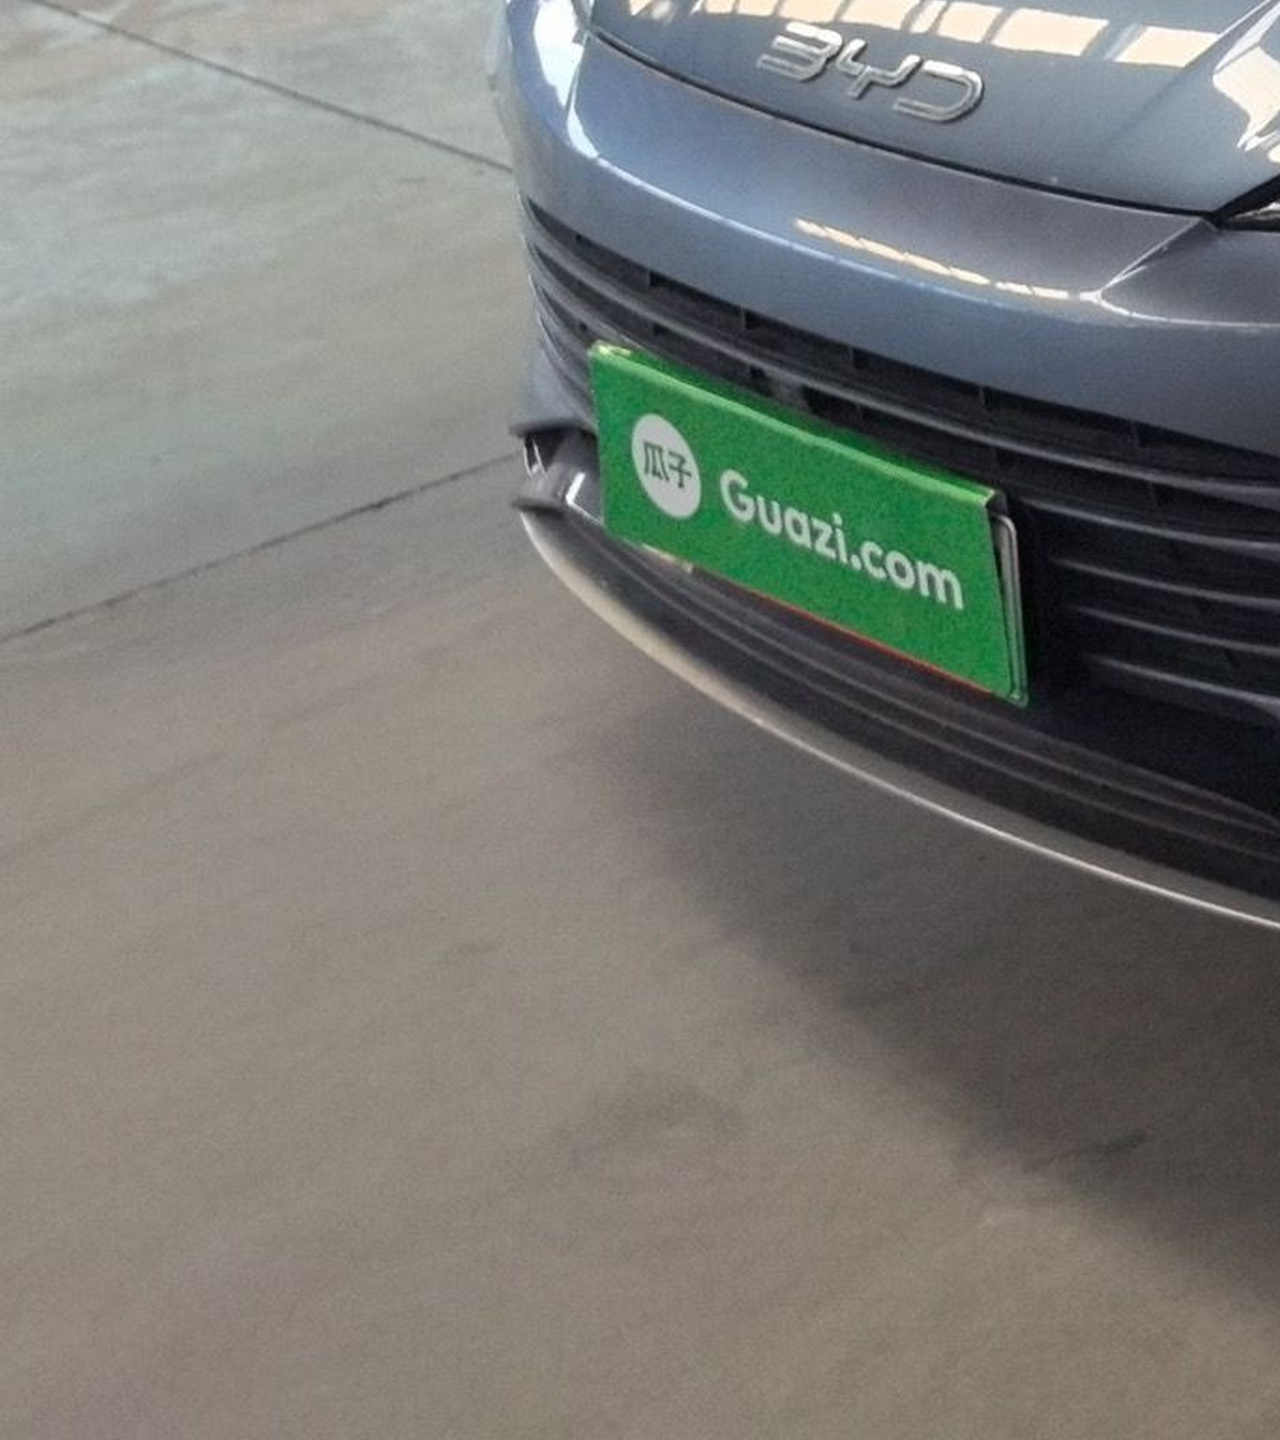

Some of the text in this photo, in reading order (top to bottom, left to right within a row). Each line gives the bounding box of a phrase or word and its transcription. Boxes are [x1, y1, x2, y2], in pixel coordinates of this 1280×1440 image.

[756, 21, 985, 124] BYD
[642, 440, 693, 489] 瓜子
[720, 469, 964, 611] Guazi.com
